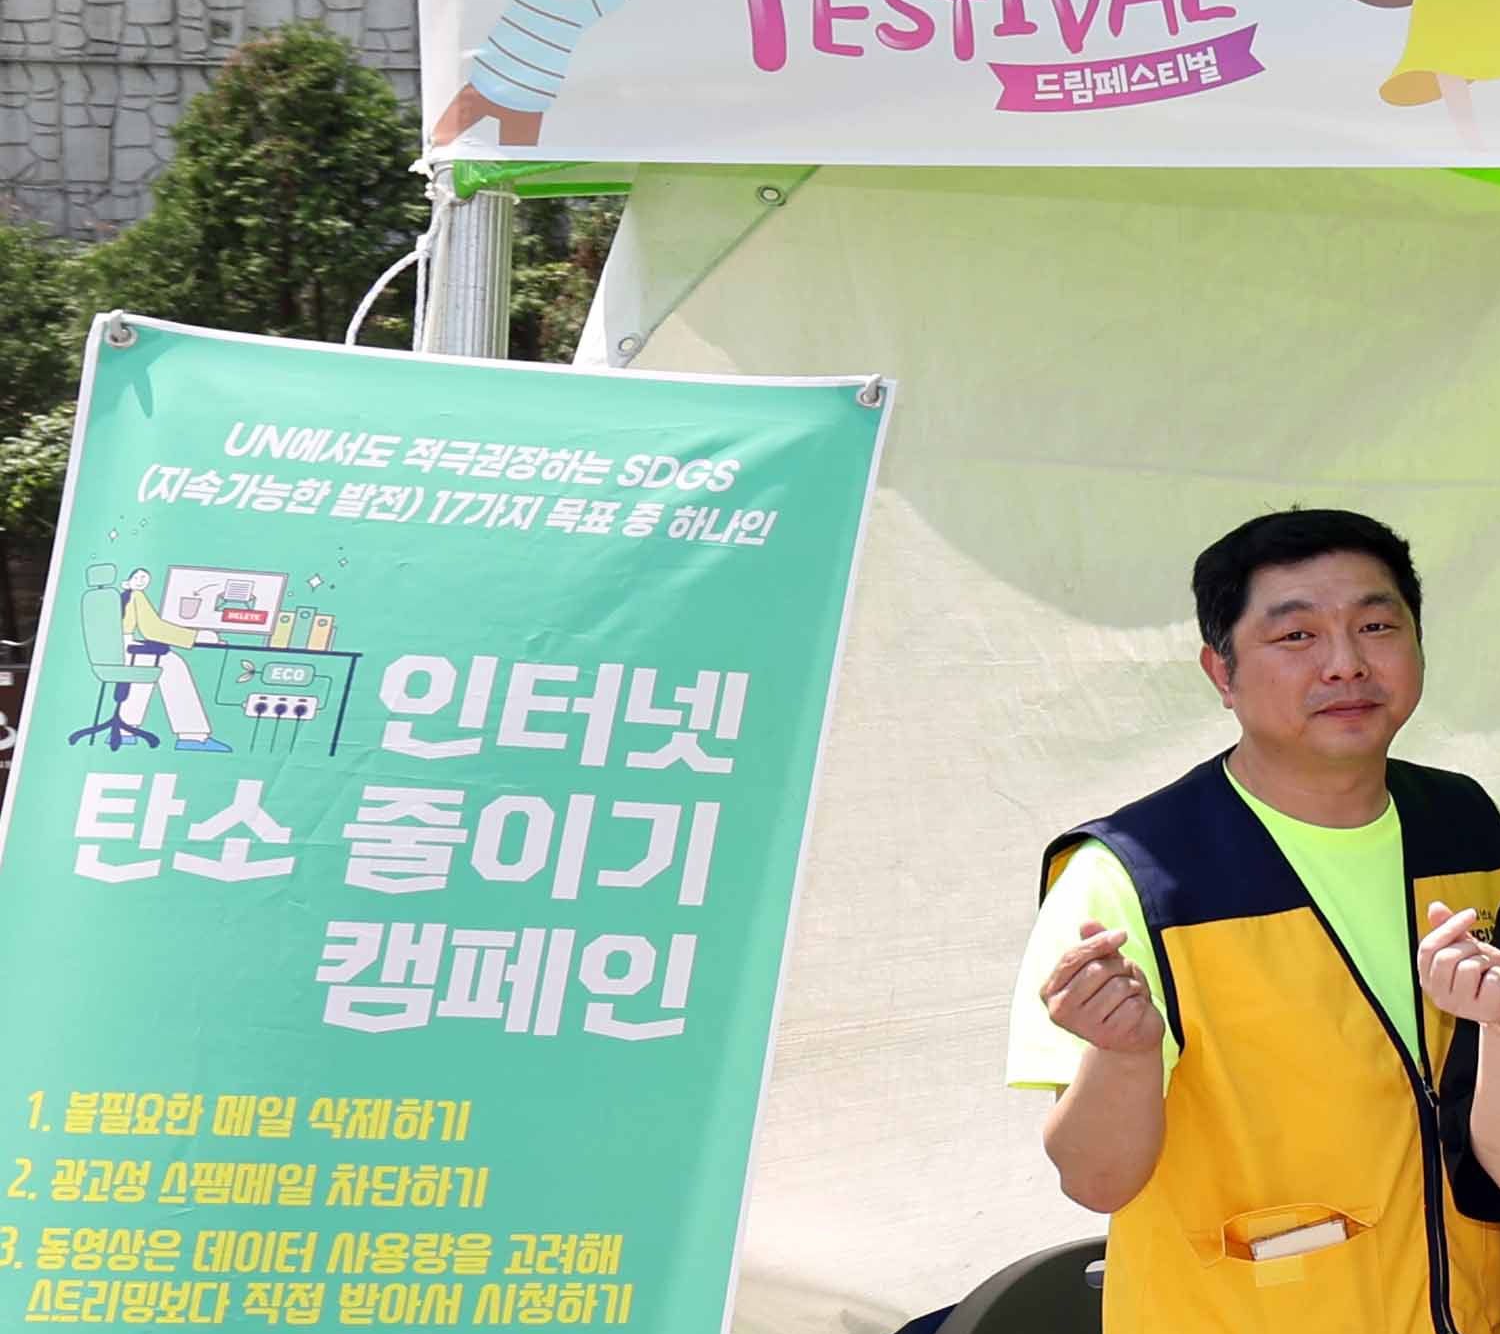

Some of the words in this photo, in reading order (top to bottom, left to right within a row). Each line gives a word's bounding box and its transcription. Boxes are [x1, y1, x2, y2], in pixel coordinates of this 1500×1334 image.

[1030, 47, 1220, 110] 드림페스티벌
[223, 421, 397, 468] UN에서도
[402, 437, 611, 488] 적극권장하는
[616, 454, 739, 494] SDGS
[137, 463, 321, 520] (지속가능한
[329, 480, 424, 525] 발전)
[427, 487, 535, 533] 17가지
[545, 498, 614, 537] 목표
[621, 502, 664, 541] 중
[666, 504, 778, 547] 하나인
[271, 667, 305, 681] ECO
[379, 653, 751, 775] 인터넷
[73, 771, 295, 884] 탄소
[343, 783, 721, 908] 줄이기
[316, 920, 698, 1043] 캠페인
[27, 1092, 51, 1132] 1.
[64, 1092, 204, 1137] 불필요한
[211, 1096, 296, 1140] 메일
[307, 1097, 472, 1142] 삭제하기
[7, 1159, 37, 1201] 2.
[50, 1158, 151, 1204] 광고성
[157, 1162, 318, 1207] 스팸메일
[325, 1163, 489, 1208] 차단하기
[0, 1226, 24, 1269] 3.
[35, 1227, 182, 1273] 동영상은
[191, 1230, 316, 1275] 데이터
[326, 1230, 493, 1275] 사용량을
[503, 1232, 624, 1276] 고려해
[24, 1280, 230, 1325] 스트리밍보다
[242, 1282, 326, 1325] 직접
[337, 1281, 462, 1325] 받아서
[471, 1281, 634, 1326] 시청하기
